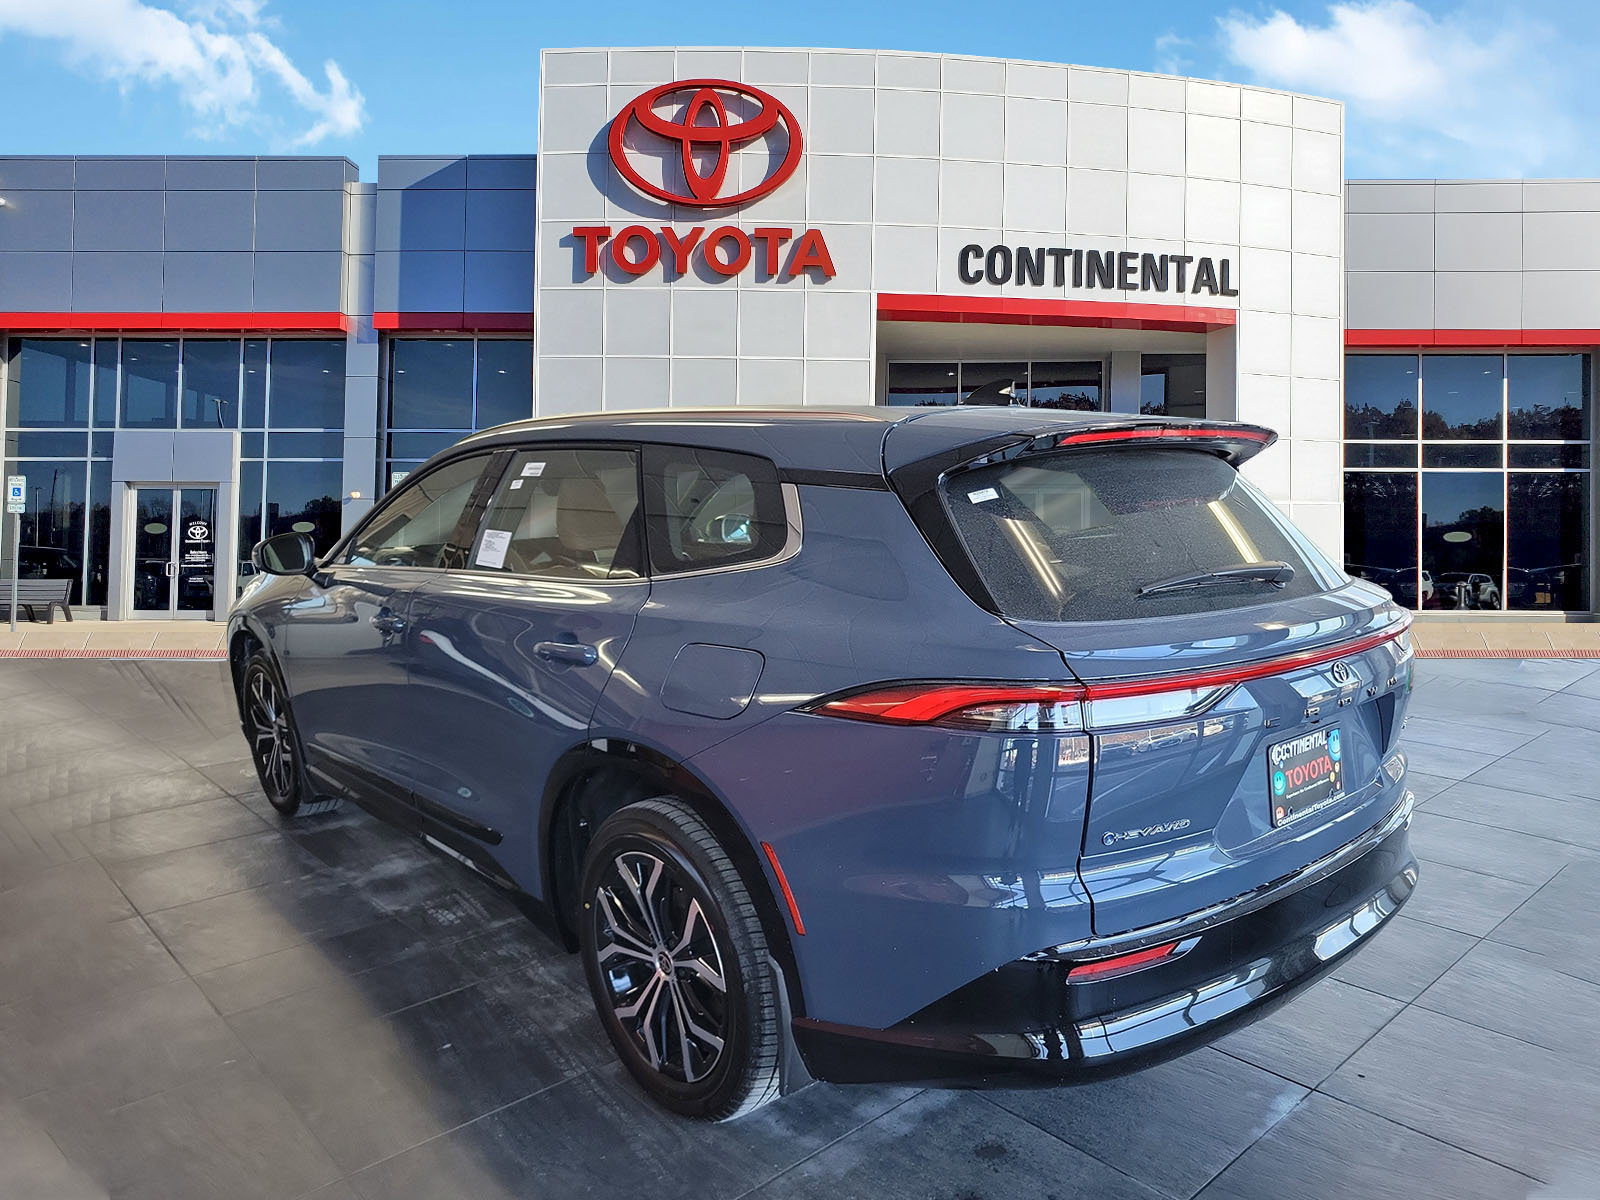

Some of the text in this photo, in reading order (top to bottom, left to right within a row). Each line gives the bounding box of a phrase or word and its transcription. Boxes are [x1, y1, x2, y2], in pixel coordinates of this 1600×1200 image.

[573, 225, 837, 276] TOYOTA
[959, 244, 1239, 297] CONTINENTAL
[1272, 730, 1328, 765] CONTINENTAL
[1285, 755, 1333, 788] TOYOTA
